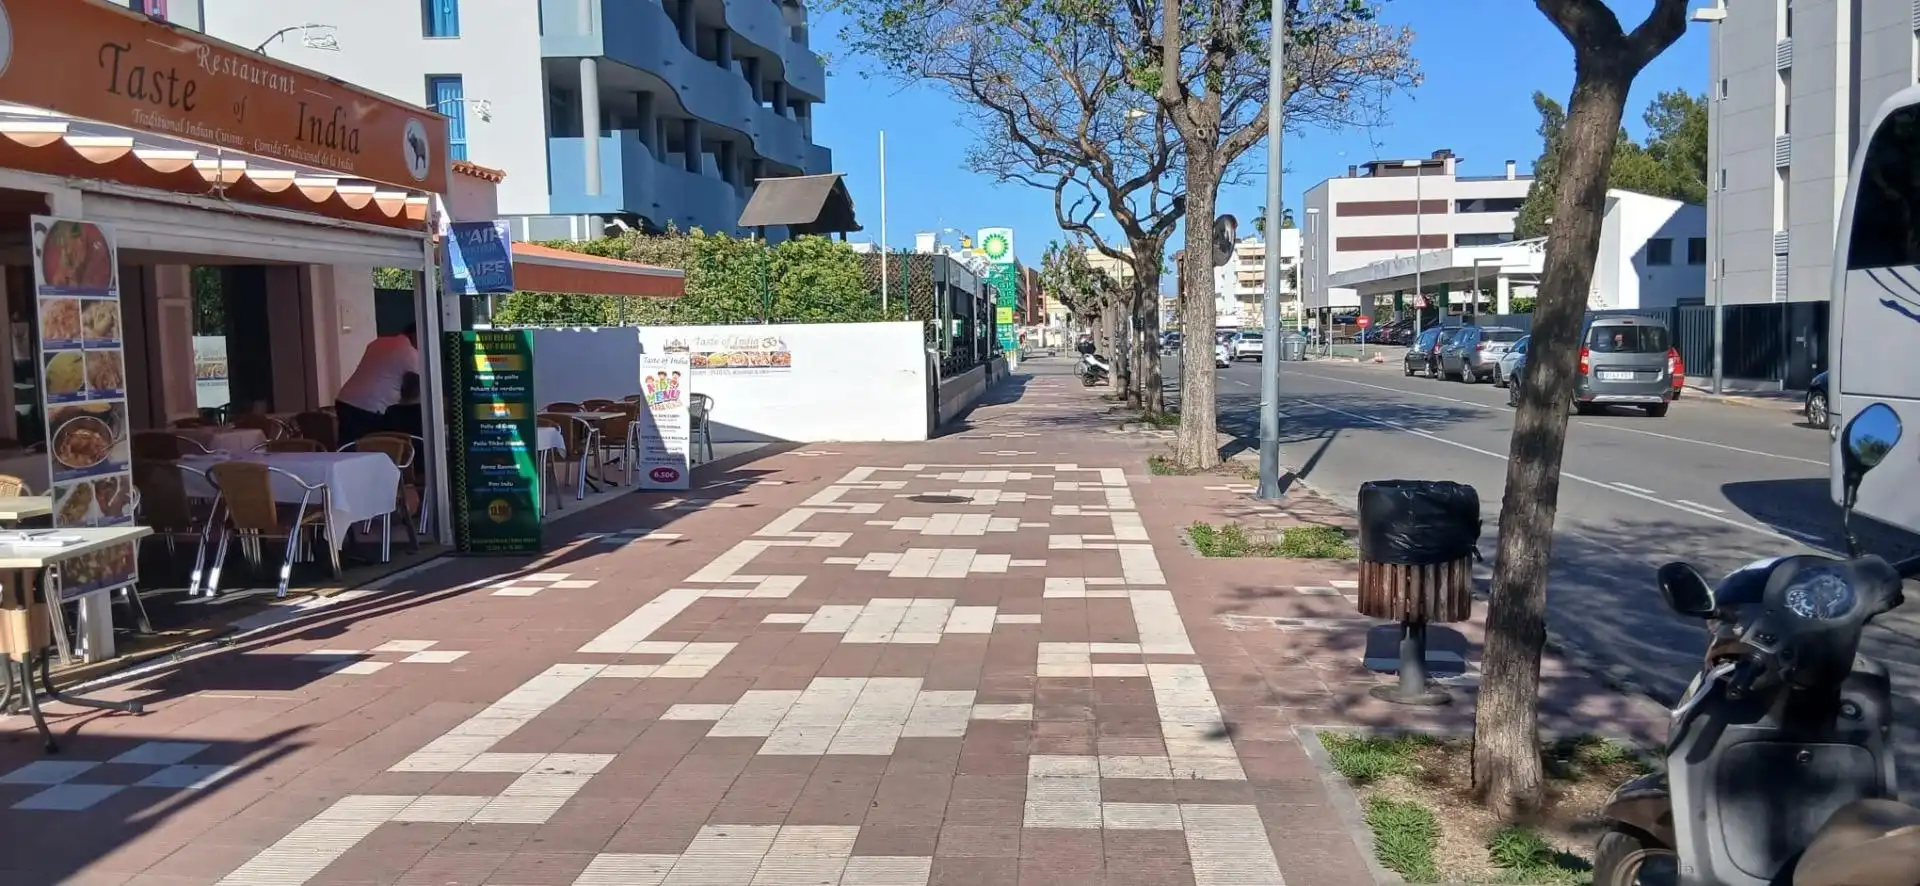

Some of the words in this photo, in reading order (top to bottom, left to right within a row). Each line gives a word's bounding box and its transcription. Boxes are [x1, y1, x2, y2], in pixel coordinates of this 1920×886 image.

[98, 41, 197, 112] Taste
[233, 96, 248, 124] of
[295, 101, 361, 155] India
[196, 43, 296, 95] Restaurant
[132, 107, 185, 134] Traditional
[185, 121, 214, 142] Indian
[215, 128, 244, 146] Cuisine
[254, 138, 282, 155] Comida
[282, 144, 320, 165] Tradicional
